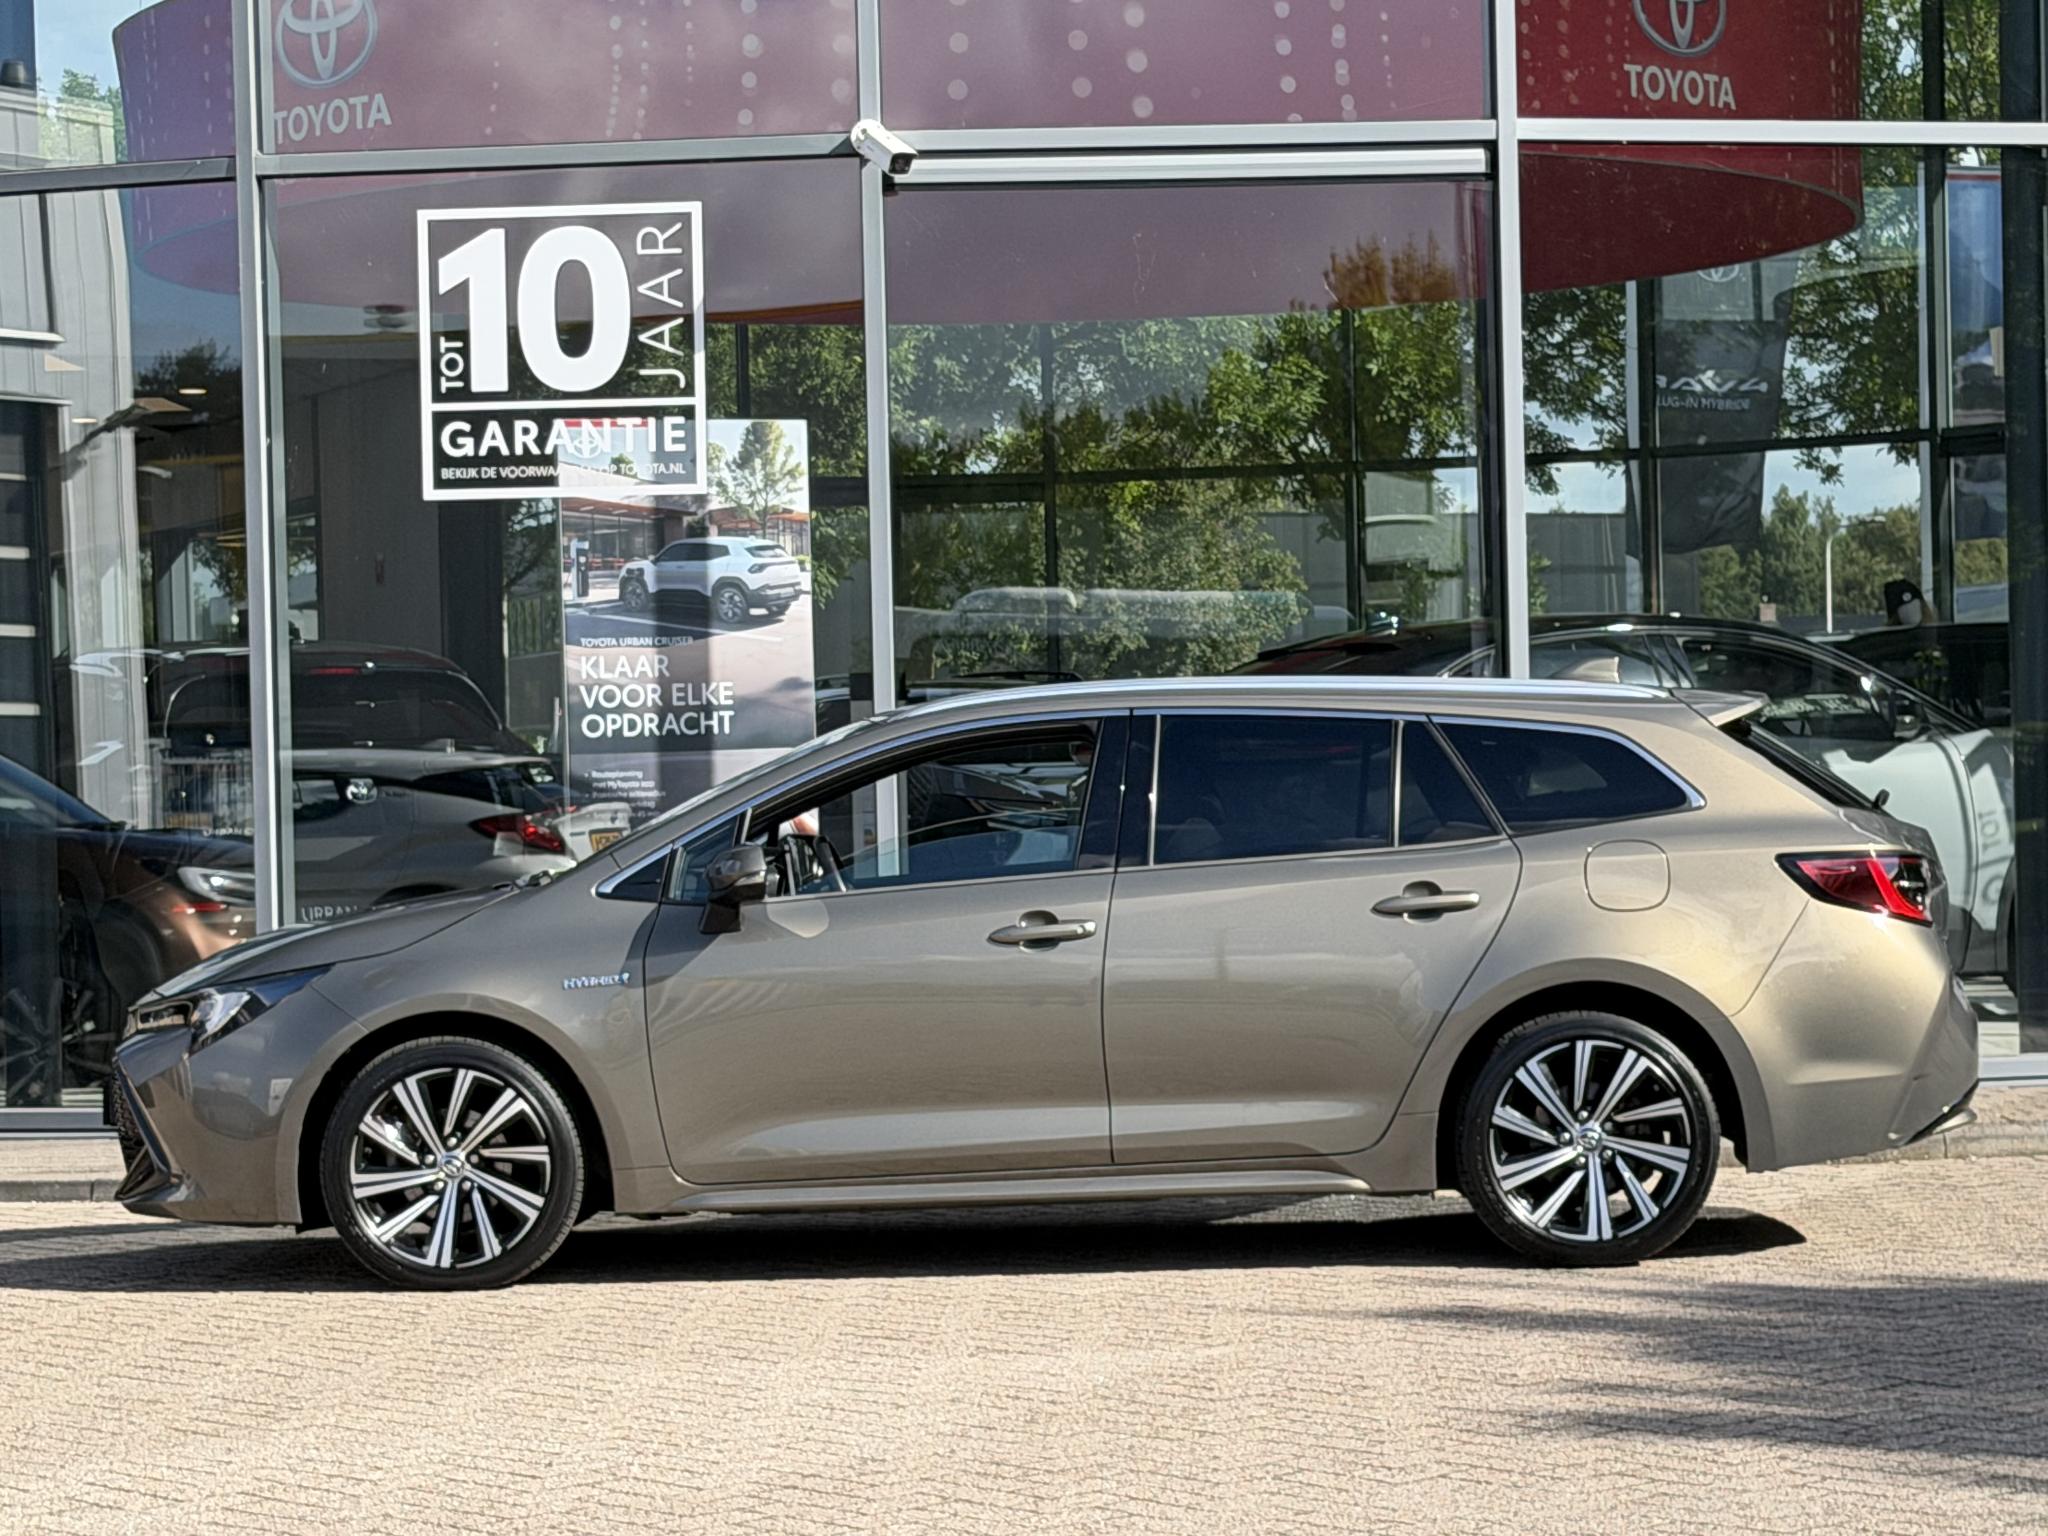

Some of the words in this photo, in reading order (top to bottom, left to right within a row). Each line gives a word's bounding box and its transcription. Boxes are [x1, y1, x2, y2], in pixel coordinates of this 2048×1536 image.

[1624, 64, 1736, 110] TOYOTA
[273, 93, 392, 144] TOYOTA
[438, 225, 631, 392] 10
[636, 222, 686, 389] JAAR
[439, 336, 464, 393] TOT
[440, 416, 687, 457] GARANTIE
[441, 467, 480, 479] BEKIJK
[481, 467, 497, 479] DE
[620, 462, 686, 475] TOOTA.NL
[580, 637, 618, 648] TOYOTA
[619, 636, 653, 647] URBAN
[580, 654, 670, 680] KLAAR
[579, 683, 663, 709] VOOR
[672, 681, 735, 706] ELKE
[581, 710, 735, 738] OPDRACHT
